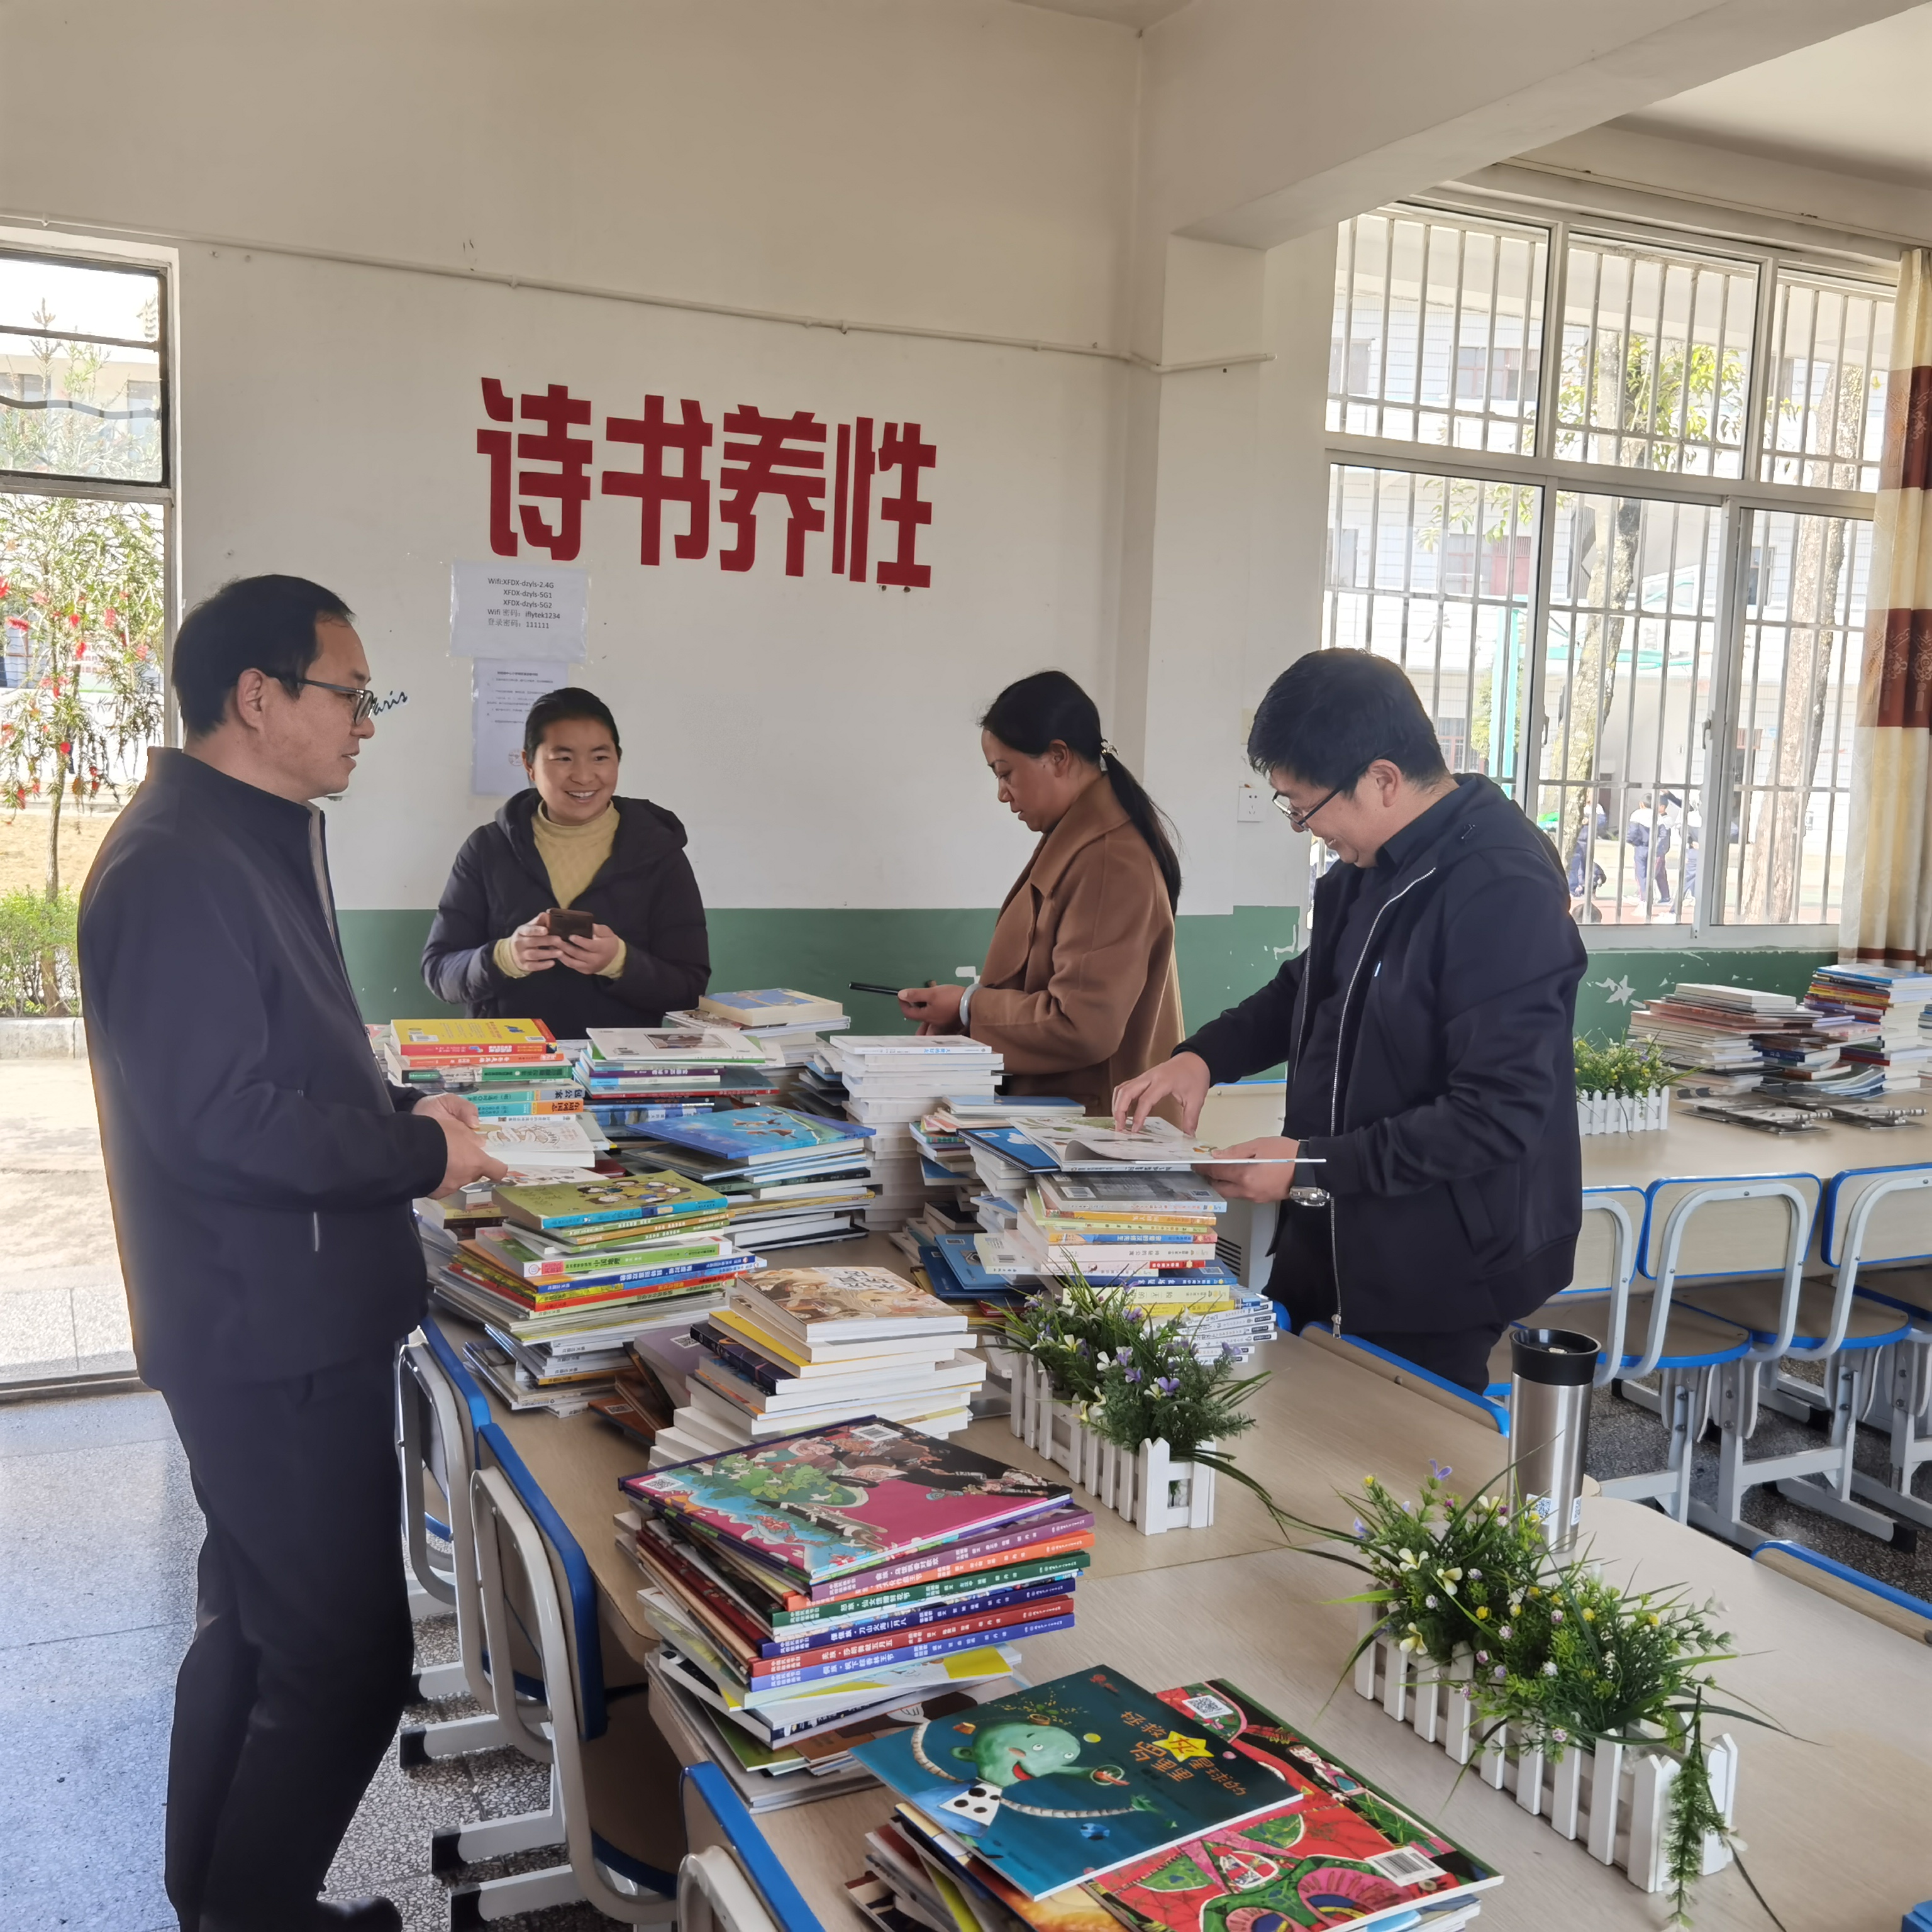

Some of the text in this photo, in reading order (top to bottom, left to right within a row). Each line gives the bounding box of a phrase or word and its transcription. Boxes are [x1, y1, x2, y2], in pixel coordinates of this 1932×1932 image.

[477, 377, 936, 587] 诗书养性
[555, 1089, 585, 1099] 包公案
[592, 1256, 621, 1269] 中国地理
[1120, 1711, 1247, 1797] 拯救灰星球的
[1129, 1740, 1194, 1782] 罗里里
